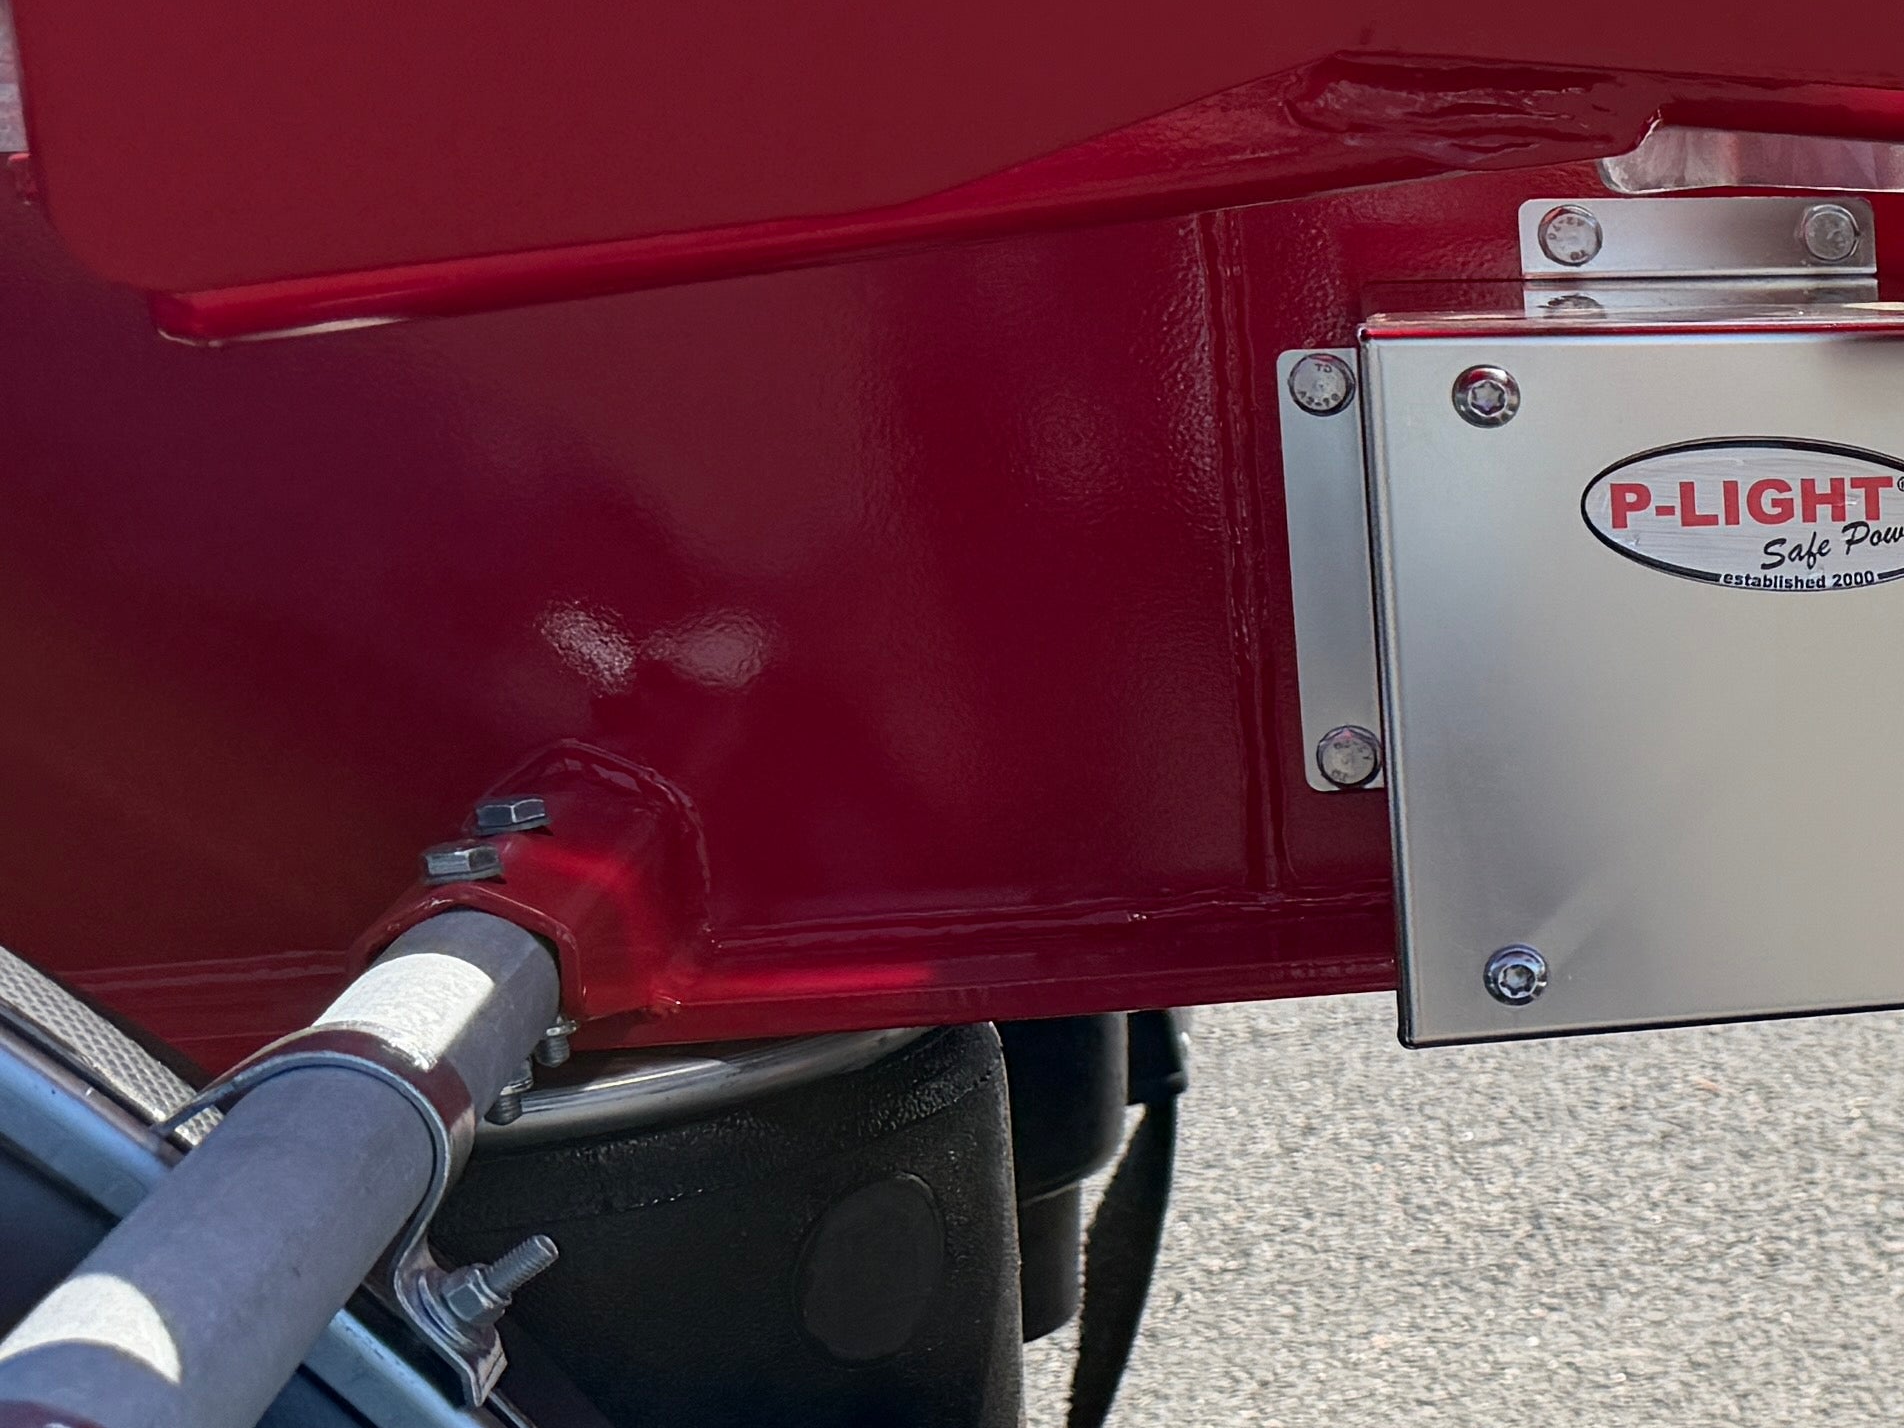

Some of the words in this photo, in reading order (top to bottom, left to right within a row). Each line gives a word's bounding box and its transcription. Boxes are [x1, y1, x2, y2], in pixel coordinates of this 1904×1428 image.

[1760, 532, 1832, 571] Safe
[1722, 572, 1826, 590] established
[1832, 570, 1875, 588] 2000
